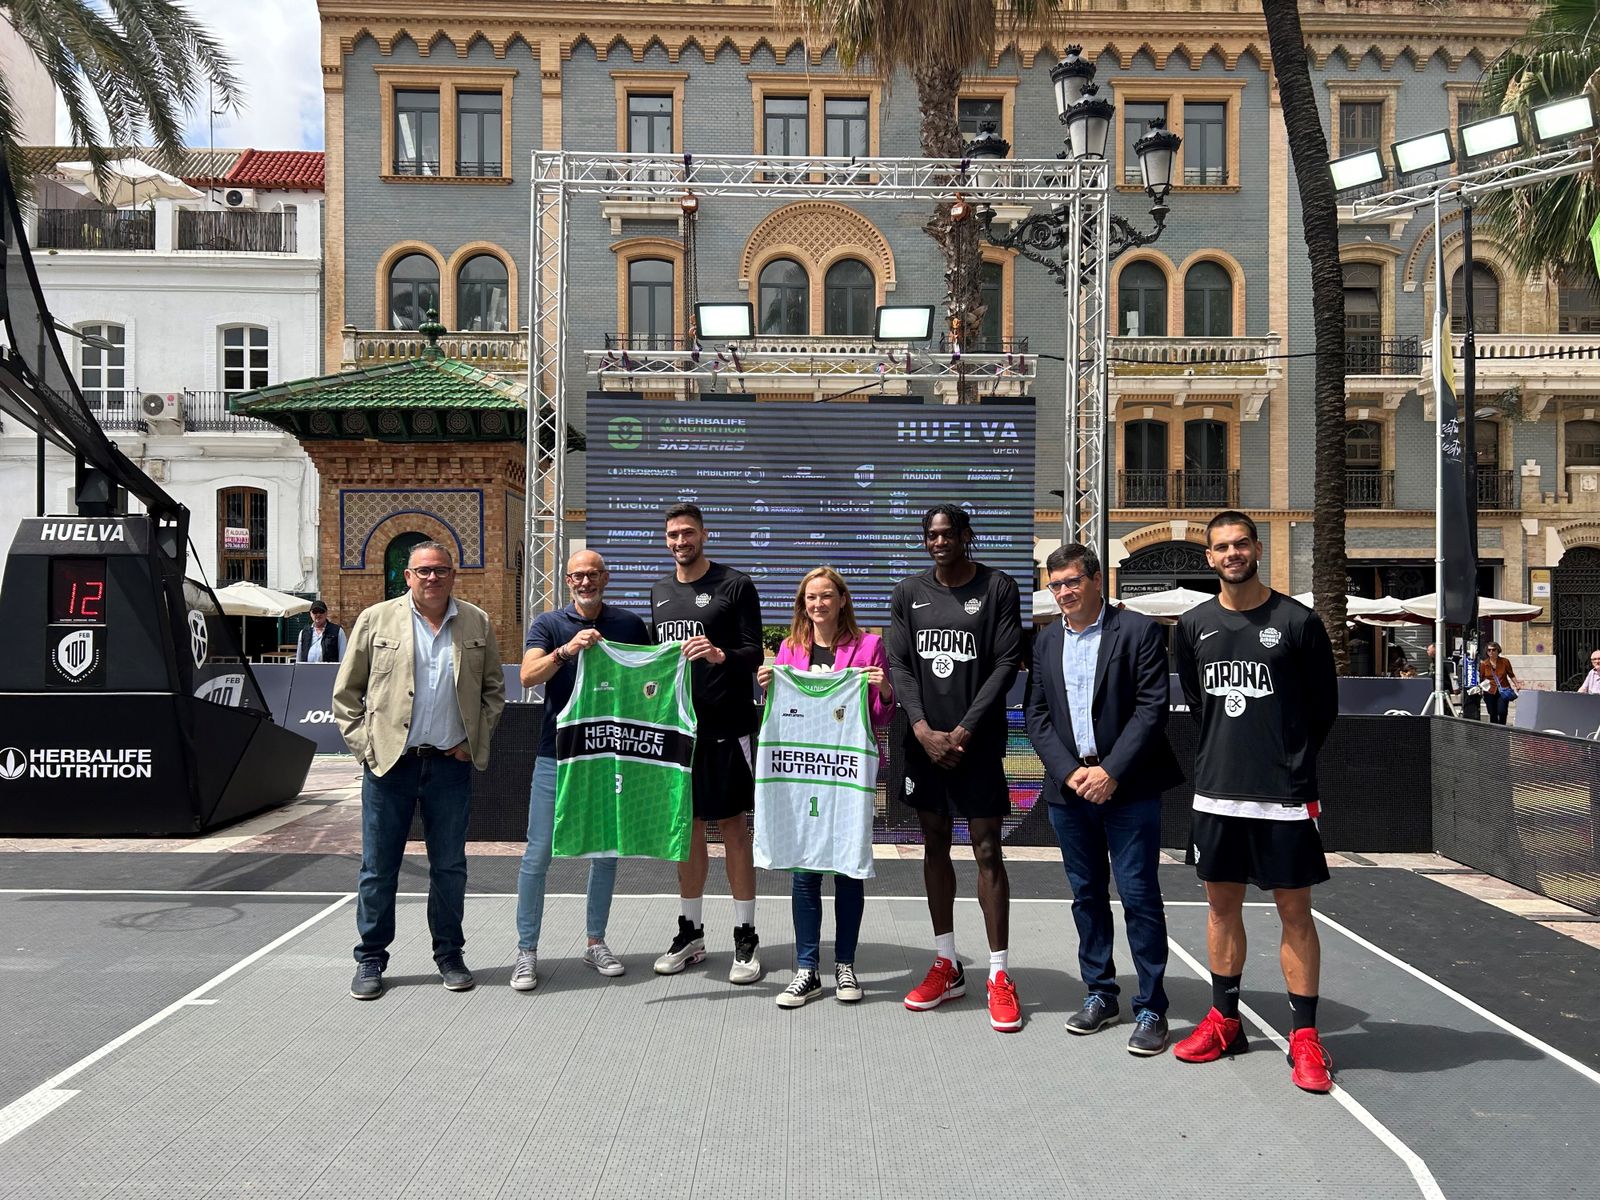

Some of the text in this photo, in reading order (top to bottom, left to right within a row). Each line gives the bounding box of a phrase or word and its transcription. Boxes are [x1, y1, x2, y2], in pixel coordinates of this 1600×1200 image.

[678, 416, 746, 425] HERBALIFE
[898, 421, 1019, 443] HUELVA
[993, 446, 1019, 454] OPEN
[40, 523, 124, 541] HUELVA
[69, 582, 103, 615] 12
[657, 620, 705, 643] GIRONA
[917, 629, 977, 657] GIRONA
[65, 640, 86, 668] 100
[1204, 660, 1274, 692] GIRONA
[299, 710, 336, 724] JOH
[585, 724, 665, 744] HERBALIFE
[30, 749, 152, 763] HERBALIFE
[585, 736, 663, 756] NUTRITION
[771, 750, 859, 767] HERBALIFE
[30, 764, 152, 778] NUTRITION
[771, 762, 858, 779] NUTRITION
[809, 796, 819, 817] 1
